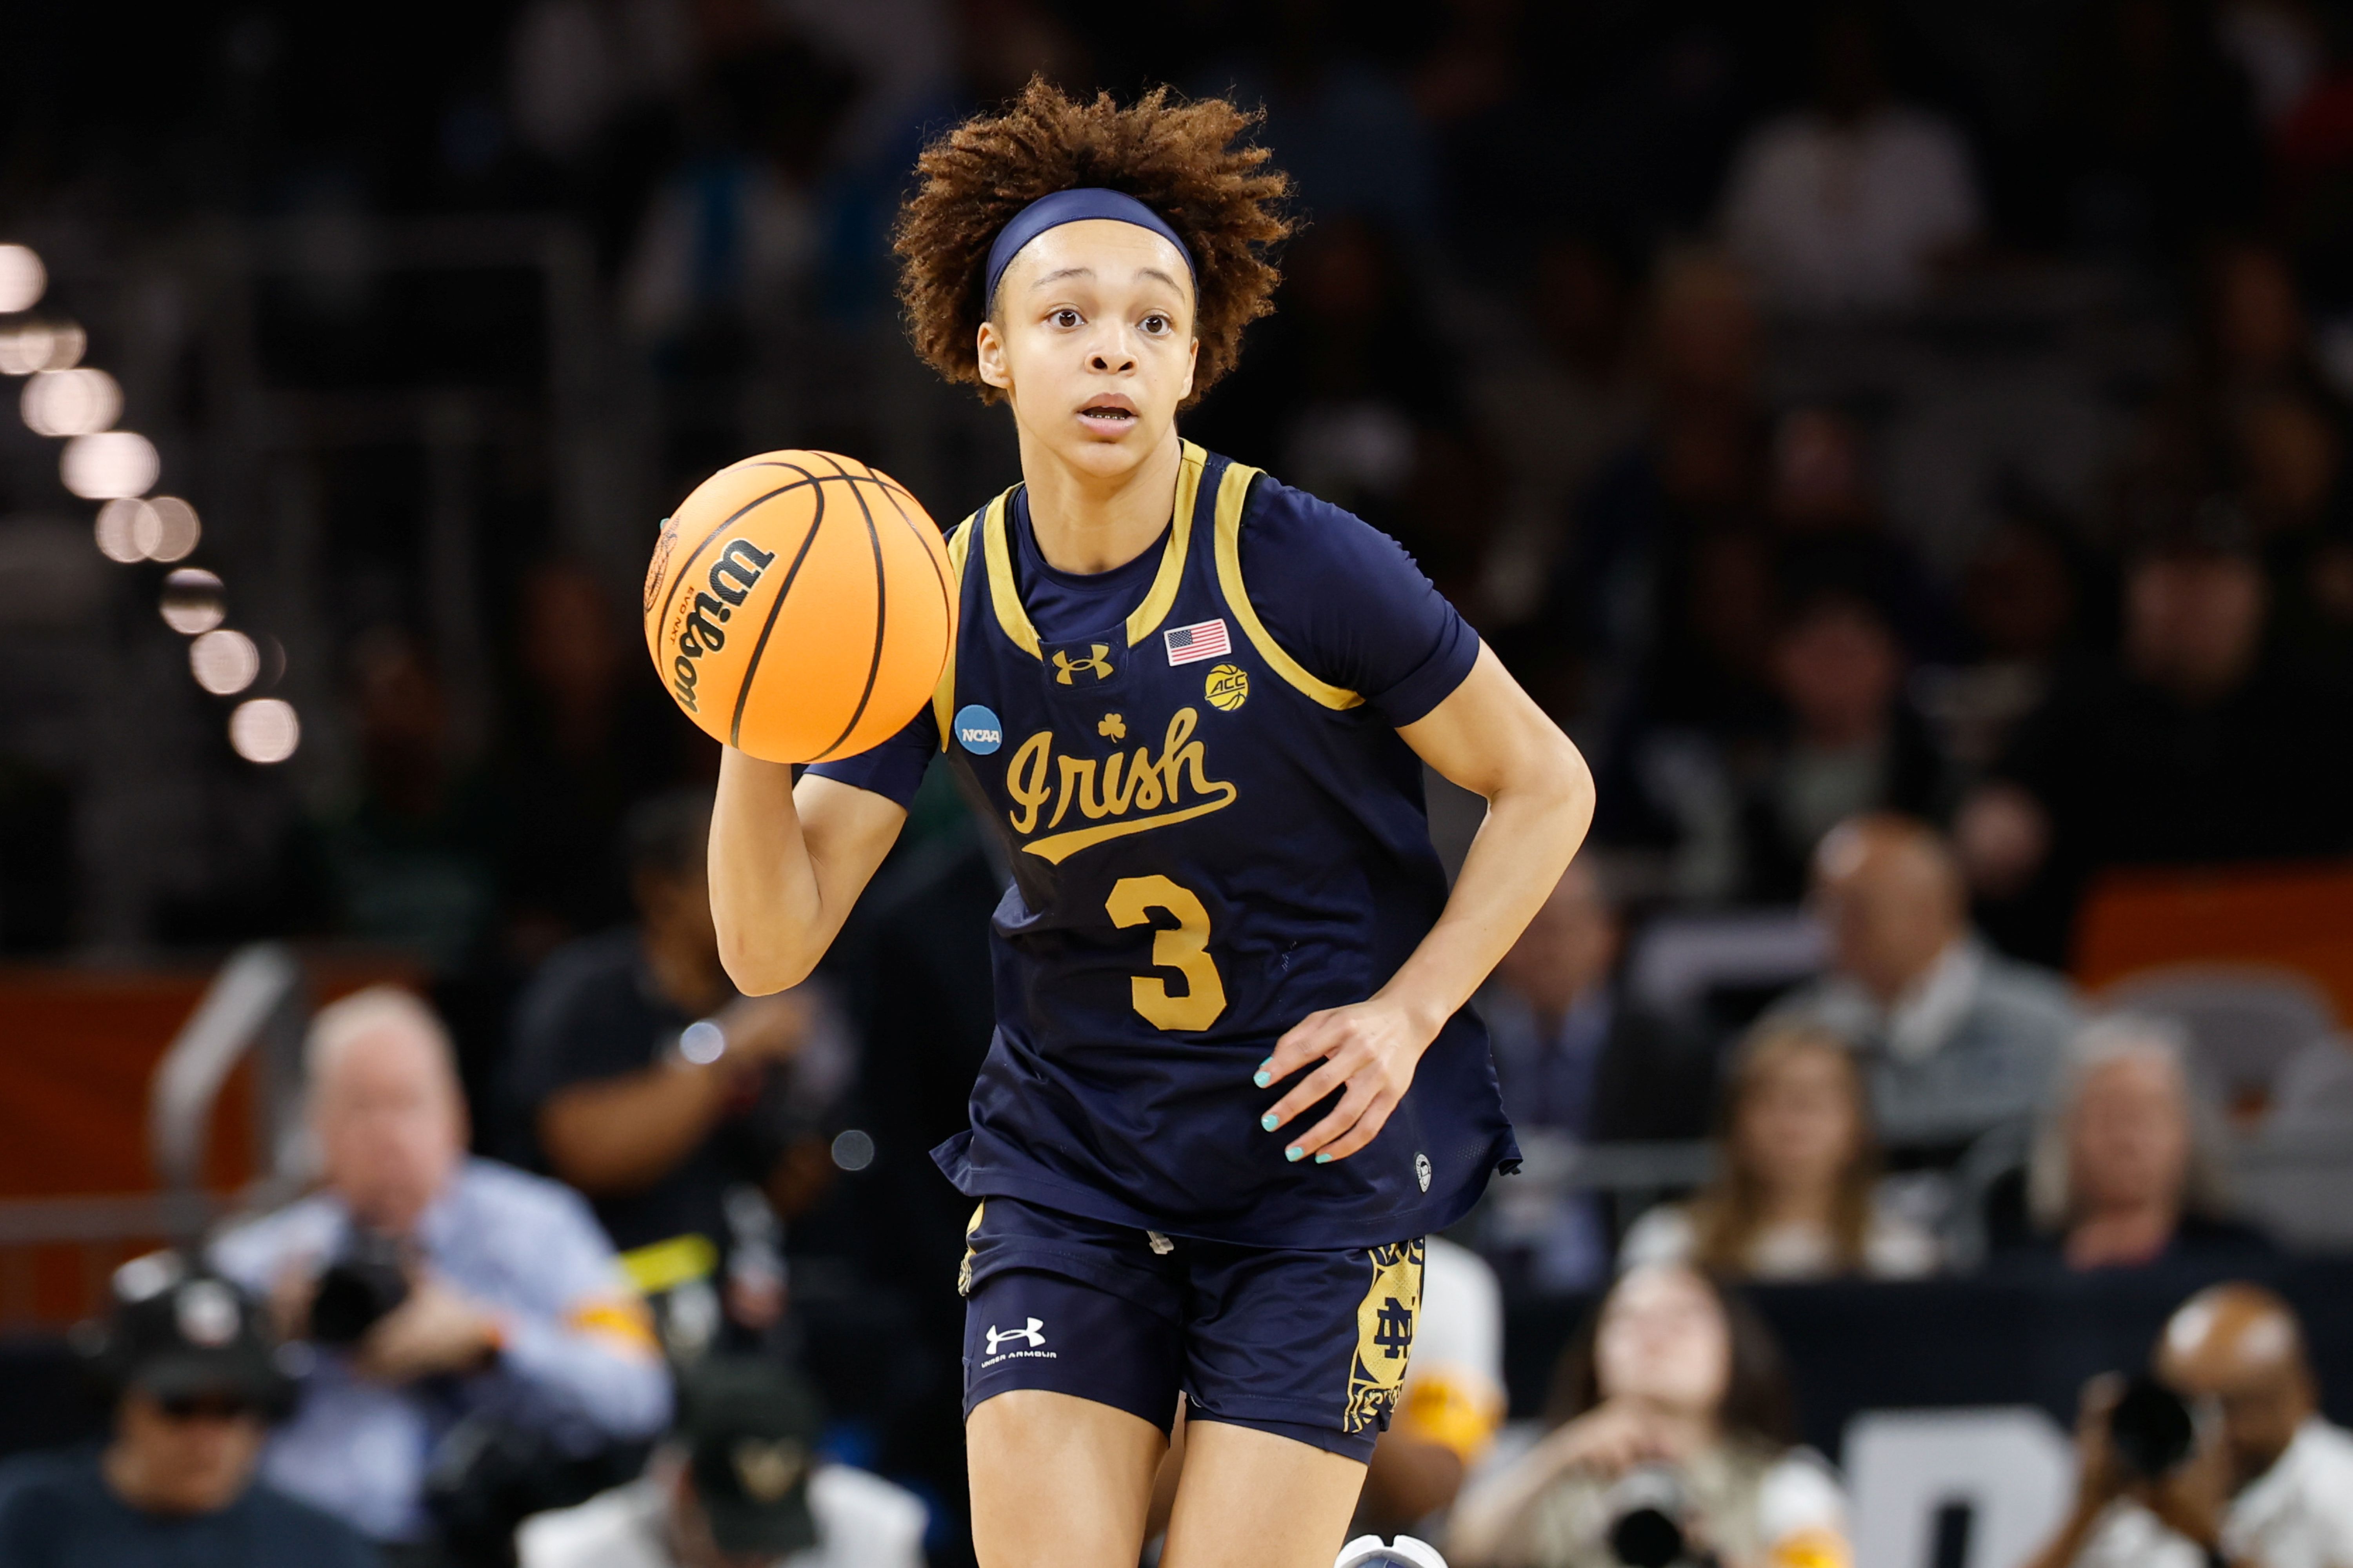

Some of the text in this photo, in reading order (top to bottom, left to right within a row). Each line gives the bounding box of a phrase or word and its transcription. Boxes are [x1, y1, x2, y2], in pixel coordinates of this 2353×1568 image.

[670, 586, 695, 645] EVO NXT
[674, 538, 778, 714] Wilson
[1210, 674, 1246, 694] ACC
[962, 728, 1000, 744] NCAA
[1007, 707, 1237, 835] Irish
[1105, 874, 1227, 1032] 3
[981, 1354, 1006, 1368] UNDER
